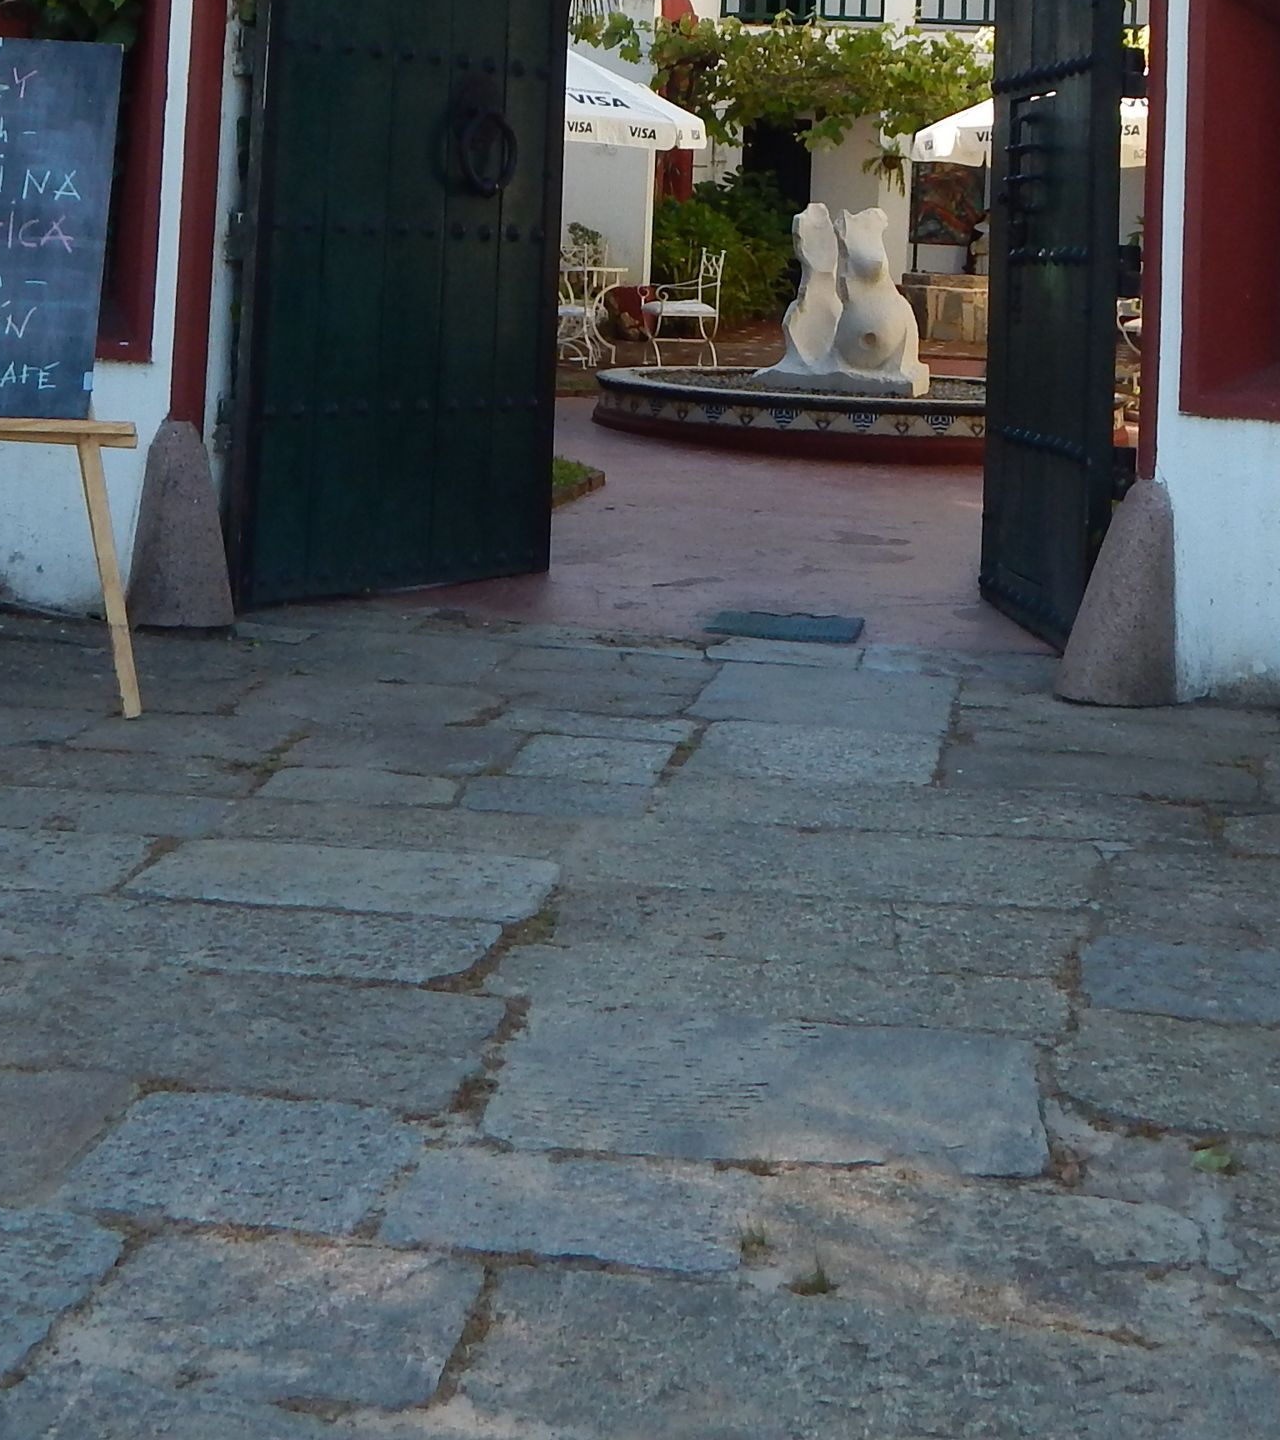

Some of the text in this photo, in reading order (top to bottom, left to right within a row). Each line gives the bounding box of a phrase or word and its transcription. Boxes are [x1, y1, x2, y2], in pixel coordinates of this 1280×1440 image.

[567, 93, 631, 109] VISA
[567, 121, 593, 133] VISA
[629, 126, 657, 140] VISA
